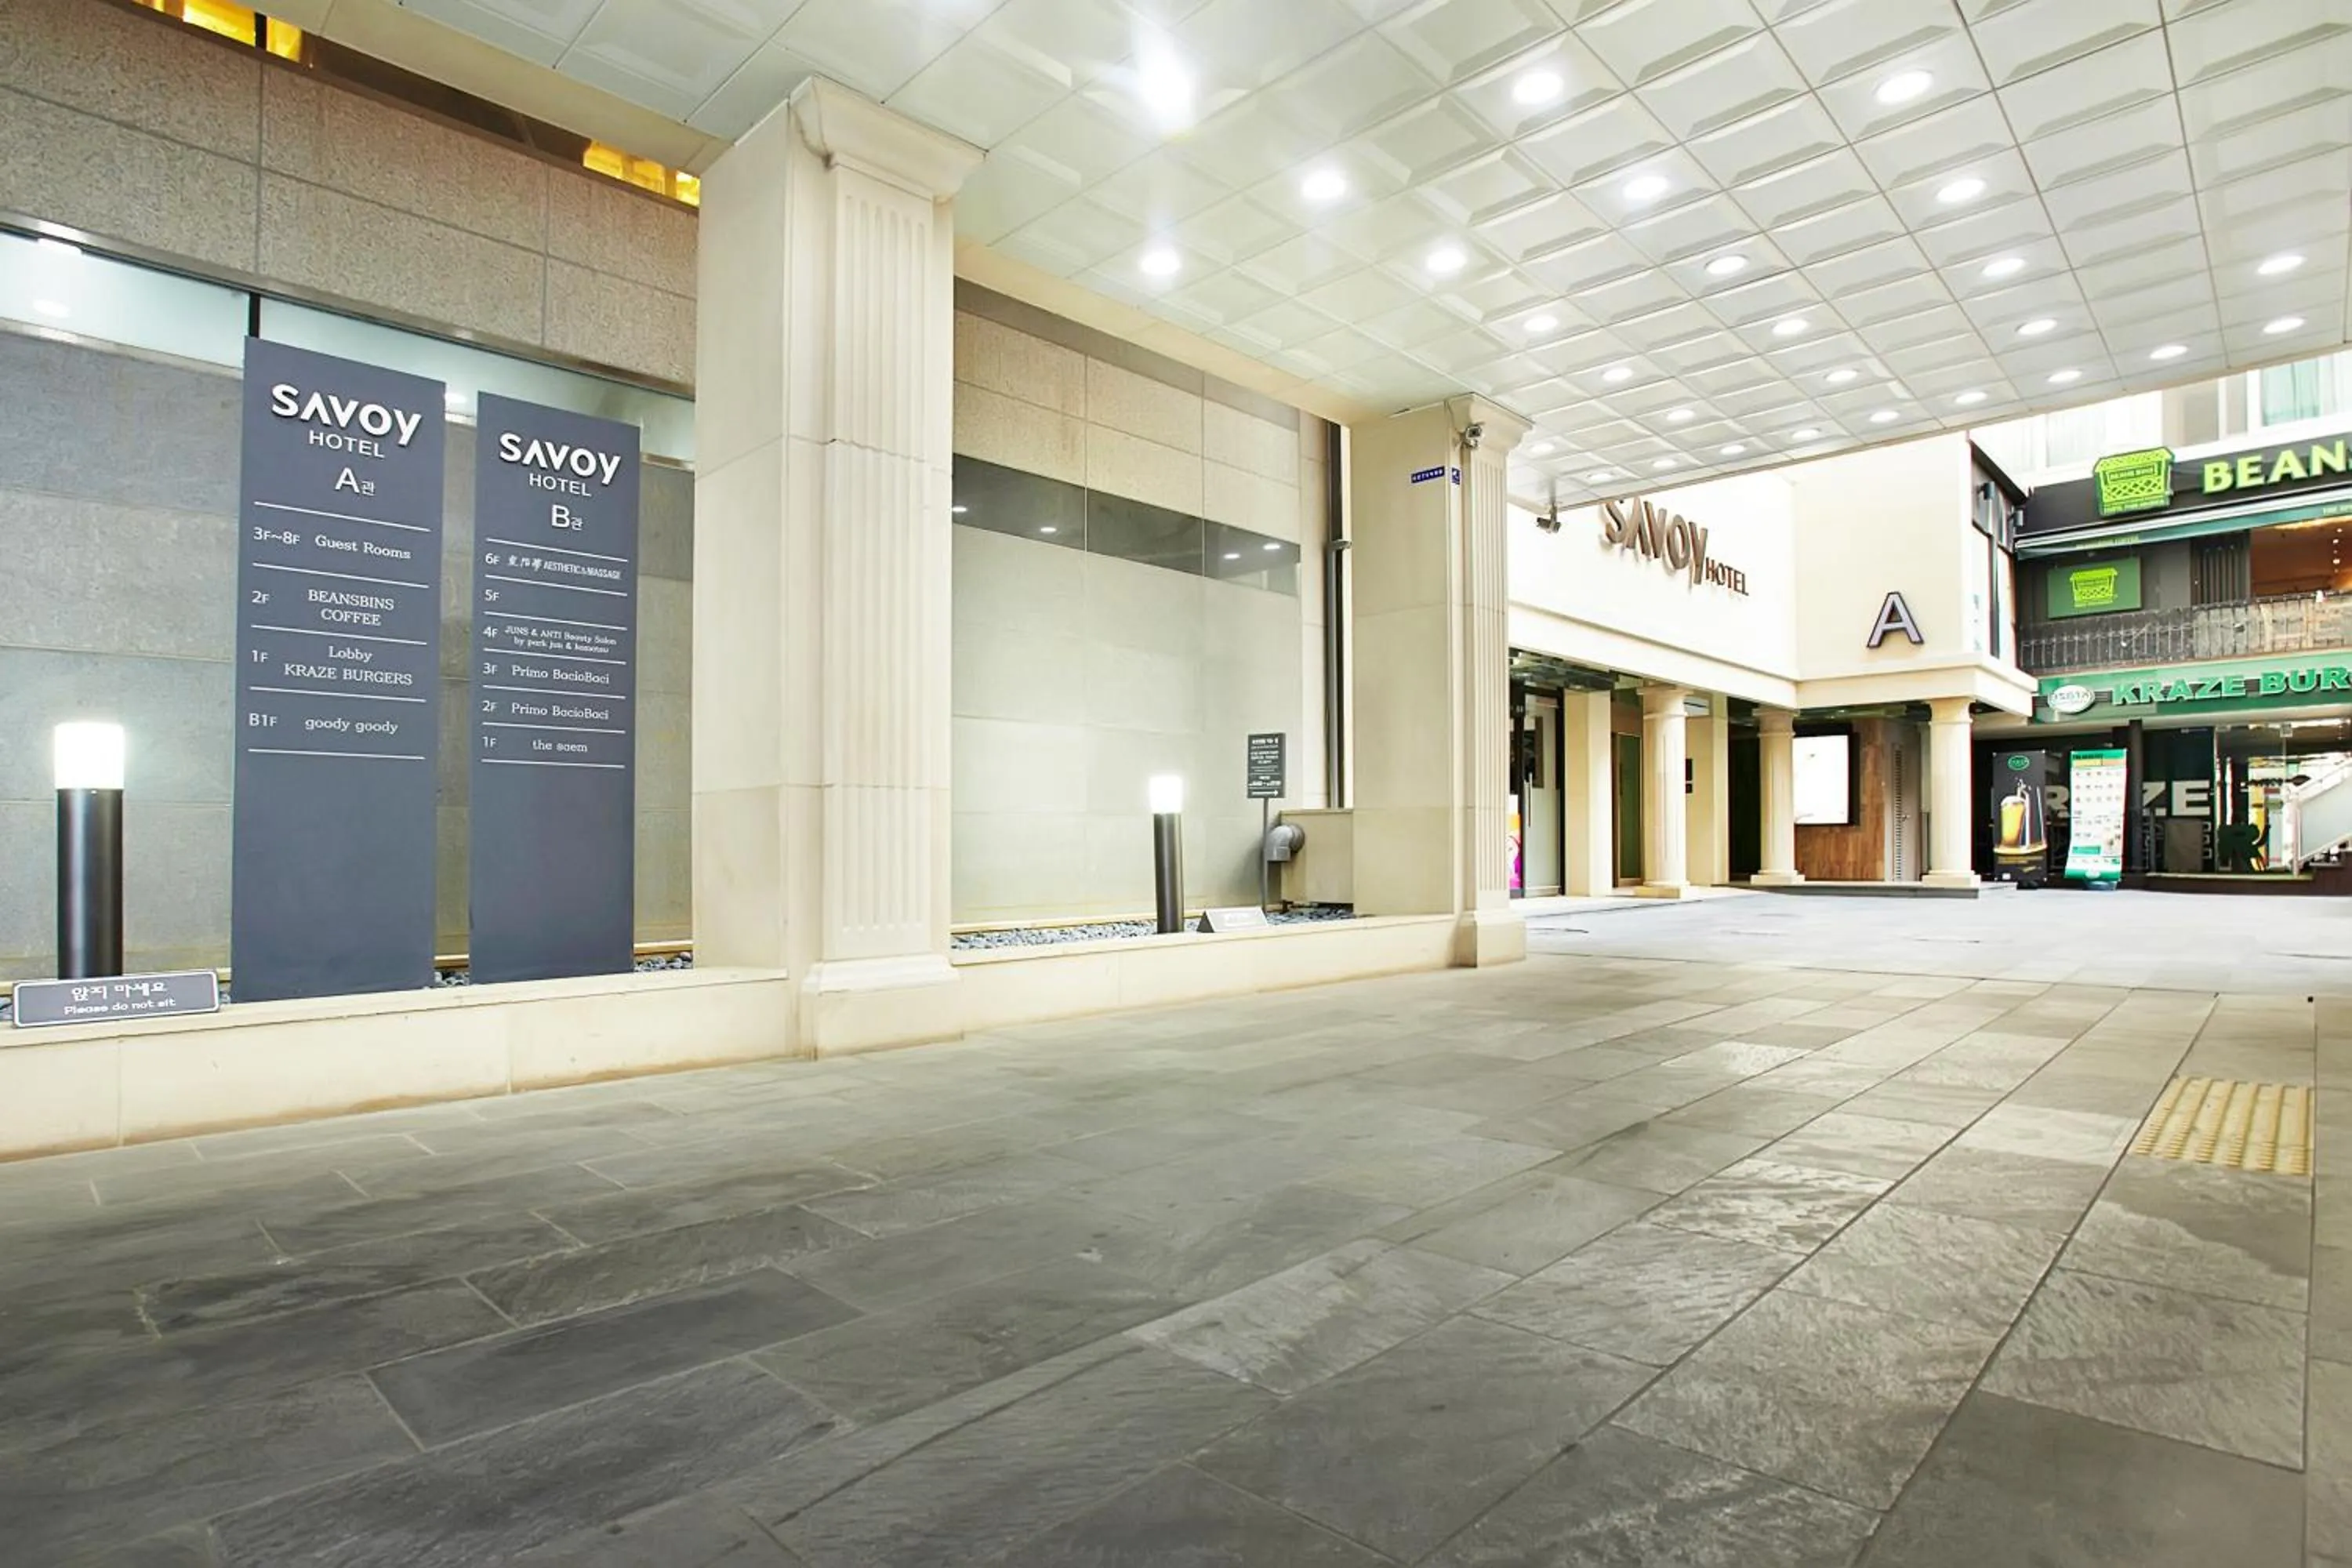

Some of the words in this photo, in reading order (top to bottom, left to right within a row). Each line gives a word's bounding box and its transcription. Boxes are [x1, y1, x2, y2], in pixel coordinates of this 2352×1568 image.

[271, 383, 422, 446] SAVOY
[309, 430, 386, 458] HOTEL
[499, 433, 622, 485] SAVOY
[2203, 439, 2352, 494] BEAN
[529, 473, 592, 497] HOTEL
[314, 535, 358, 552] Guest
[363, 542, 411, 559] Rooms
[1602, 495, 1708, 585] SAVOY
[1705, 557, 1750, 597] HOTEL
[485, 553, 500, 564] 6F
[252, 590, 270, 604] 2F
[308, 589, 394, 611] BEANSBINS
[484, 589, 499, 601] 5F
[321, 608, 381, 626] COFFEE
[1866, 591, 1925, 648] A
[483, 626, 499, 638] 4F
[514, 637, 524, 646] by
[252, 649, 269, 662] 1F
[328, 646, 373, 662] Lobby
[285, 663, 337, 680] KRAZE
[343, 668, 413, 685] BURGERS
[483, 662, 498, 674] 3F
[512, 665, 548, 679] Primo
[2111, 673, 2247, 706] KRAZE
[482, 700, 497, 712] 2F
[511, 702, 548, 717] Primo
[249, 713, 277, 728] B1F
[305, 718, 350, 732] goody
[355, 720, 398, 735] goody
[483, 736, 496, 748] 1F
[532, 740, 553, 751] the
[556, 742, 588, 753] saem
[71, 985, 107, 1002] 앉지
[114, 982, 167, 998] 마세요
[64, 1004, 108, 1015] Please
[112, 1003, 128, 1011] do
[132, 1000, 154, 1009] not
[158, 998, 176, 1007] sit
